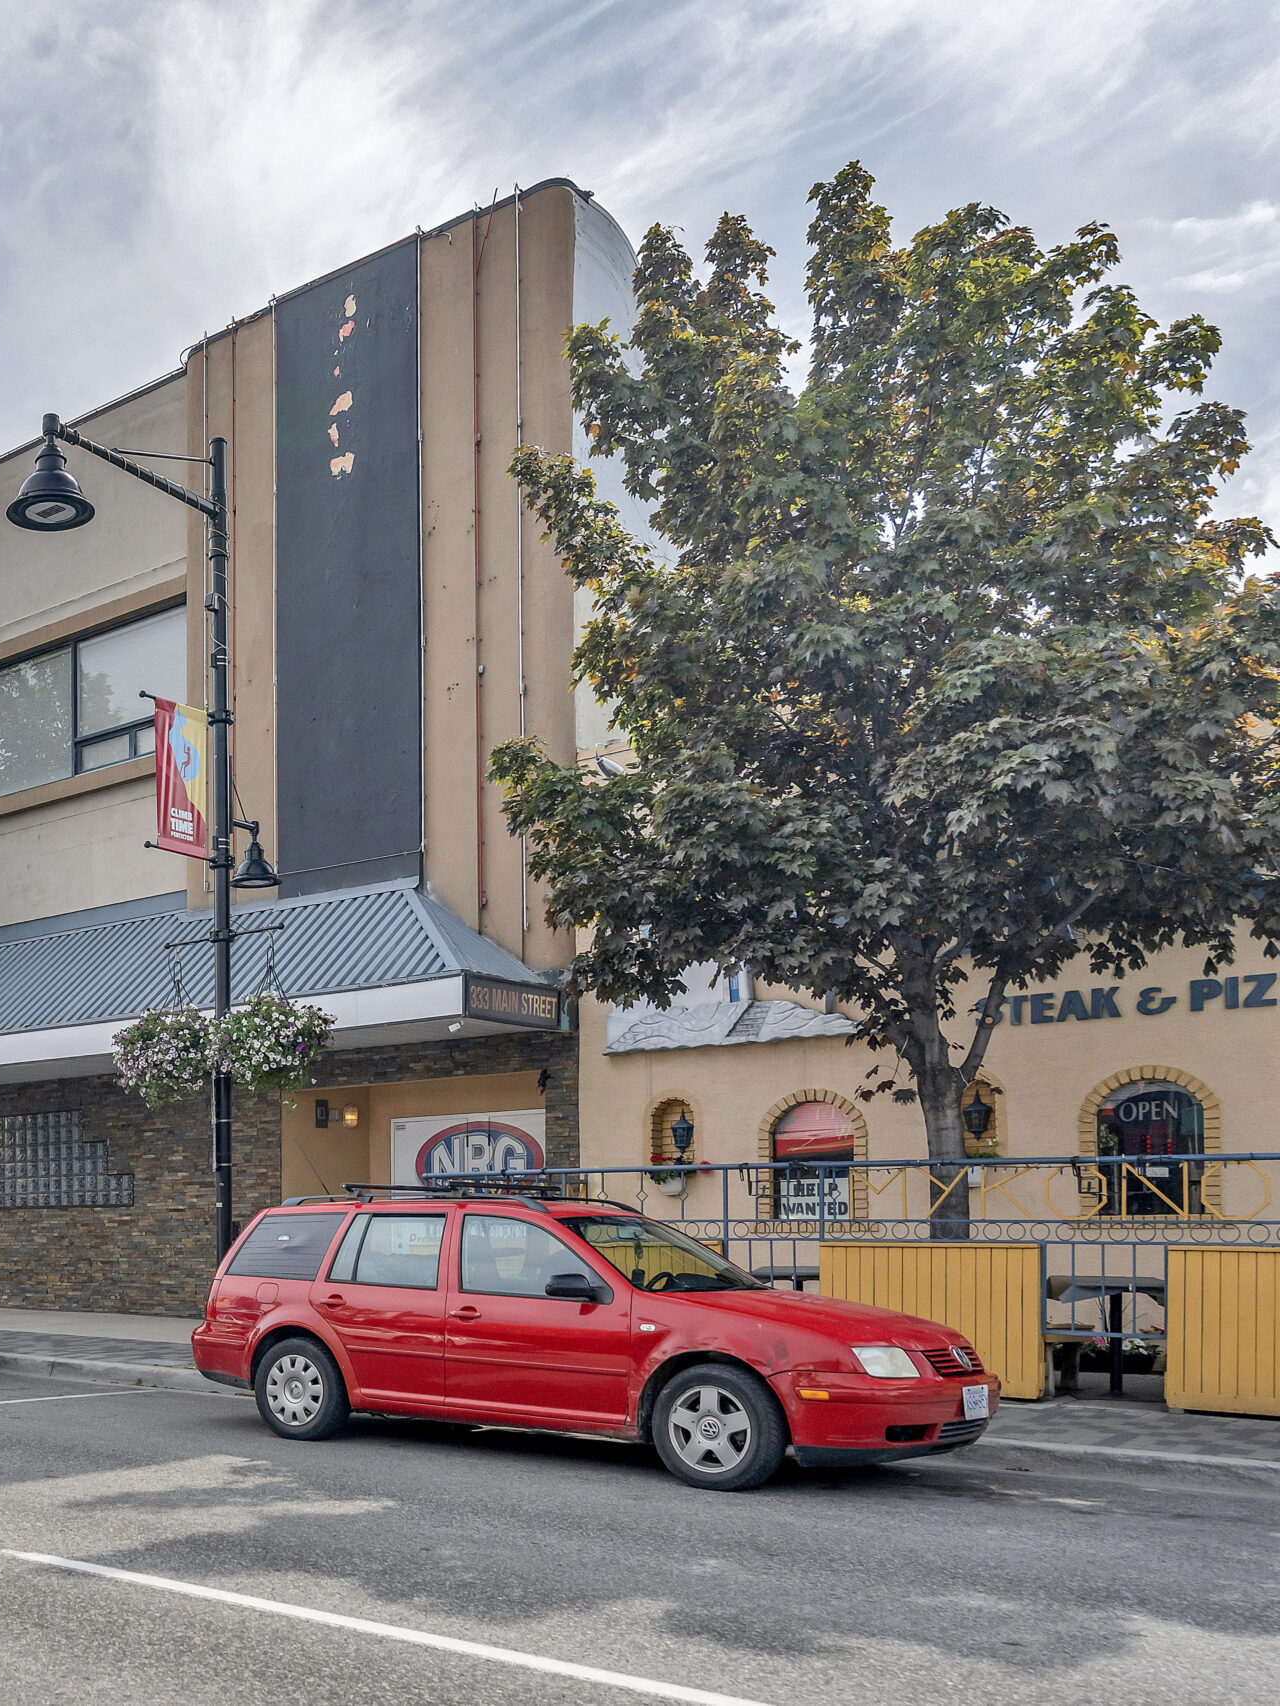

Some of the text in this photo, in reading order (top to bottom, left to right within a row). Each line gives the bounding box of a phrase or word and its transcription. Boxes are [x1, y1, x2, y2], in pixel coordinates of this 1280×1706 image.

[171, 807, 192, 821] CLIMB
[171, 818, 193, 835] TIME
[171, 831, 193, 842] PENTICTON
[470, 985, 557, 1019] 333 MAIN STREET
[1136, 987, 1177, 1016] &
[1190, 972, 1278, 1012] PIZ
[1119, 1100, 1178, 1122] OPEN
[430, 1131, 528, 1190] NRG
[793, 1182, 838, 1197] HELP
